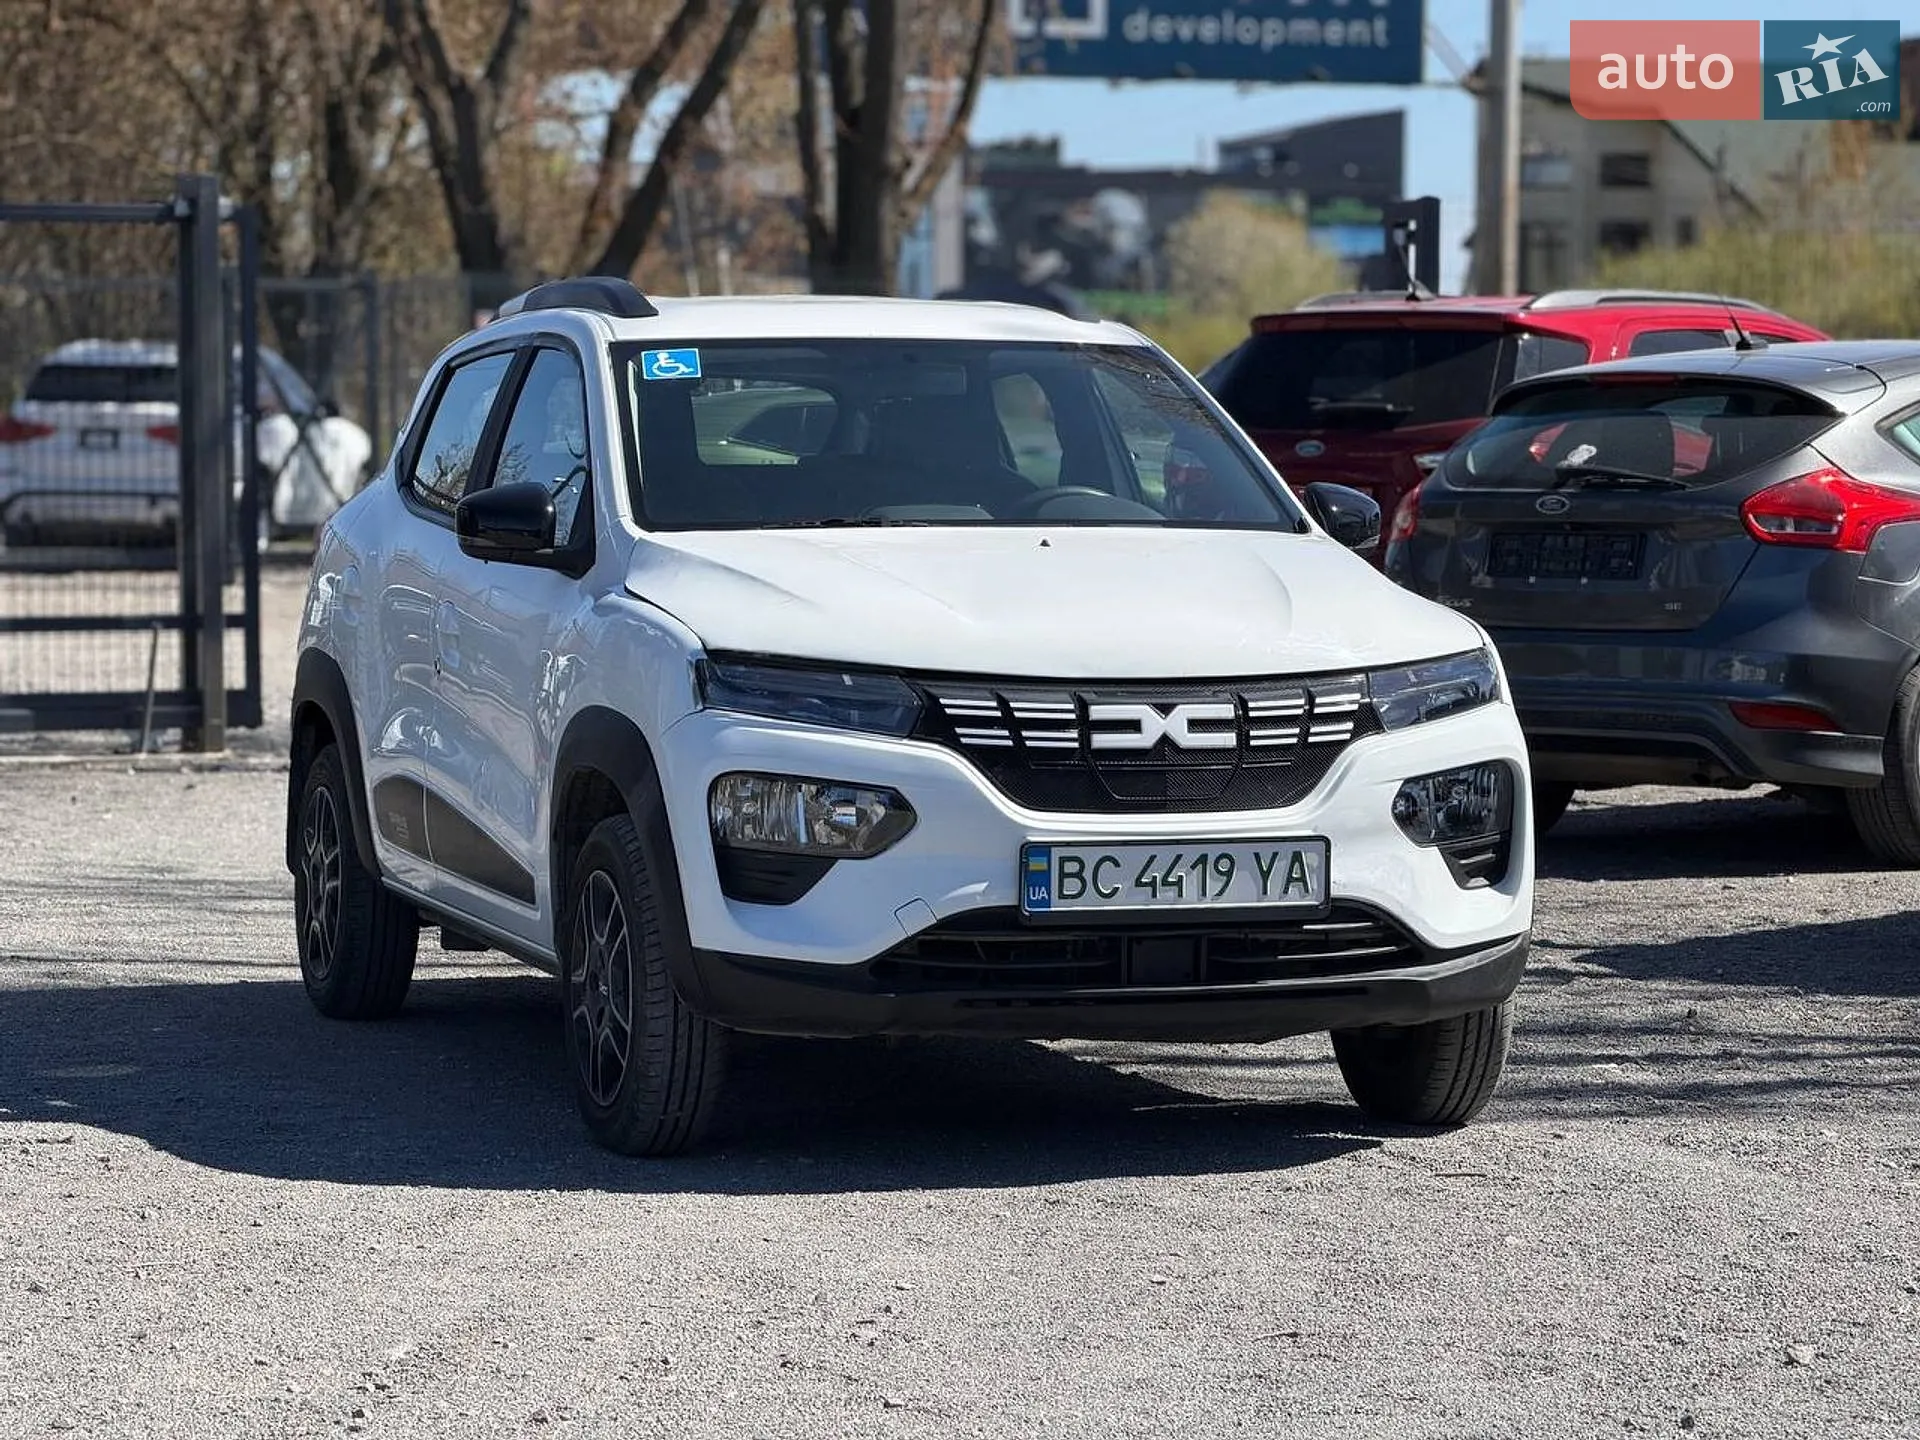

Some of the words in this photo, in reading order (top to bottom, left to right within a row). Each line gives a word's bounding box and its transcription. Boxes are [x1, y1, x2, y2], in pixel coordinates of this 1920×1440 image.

[1122, 9, 1389, 51] development
[1029, 886, 1048, 901] UA
[1057, 855, 1122, 900] BC
[1134, 853, 1236, 899] 4419
[1253, 851, 1310, 895] YA
